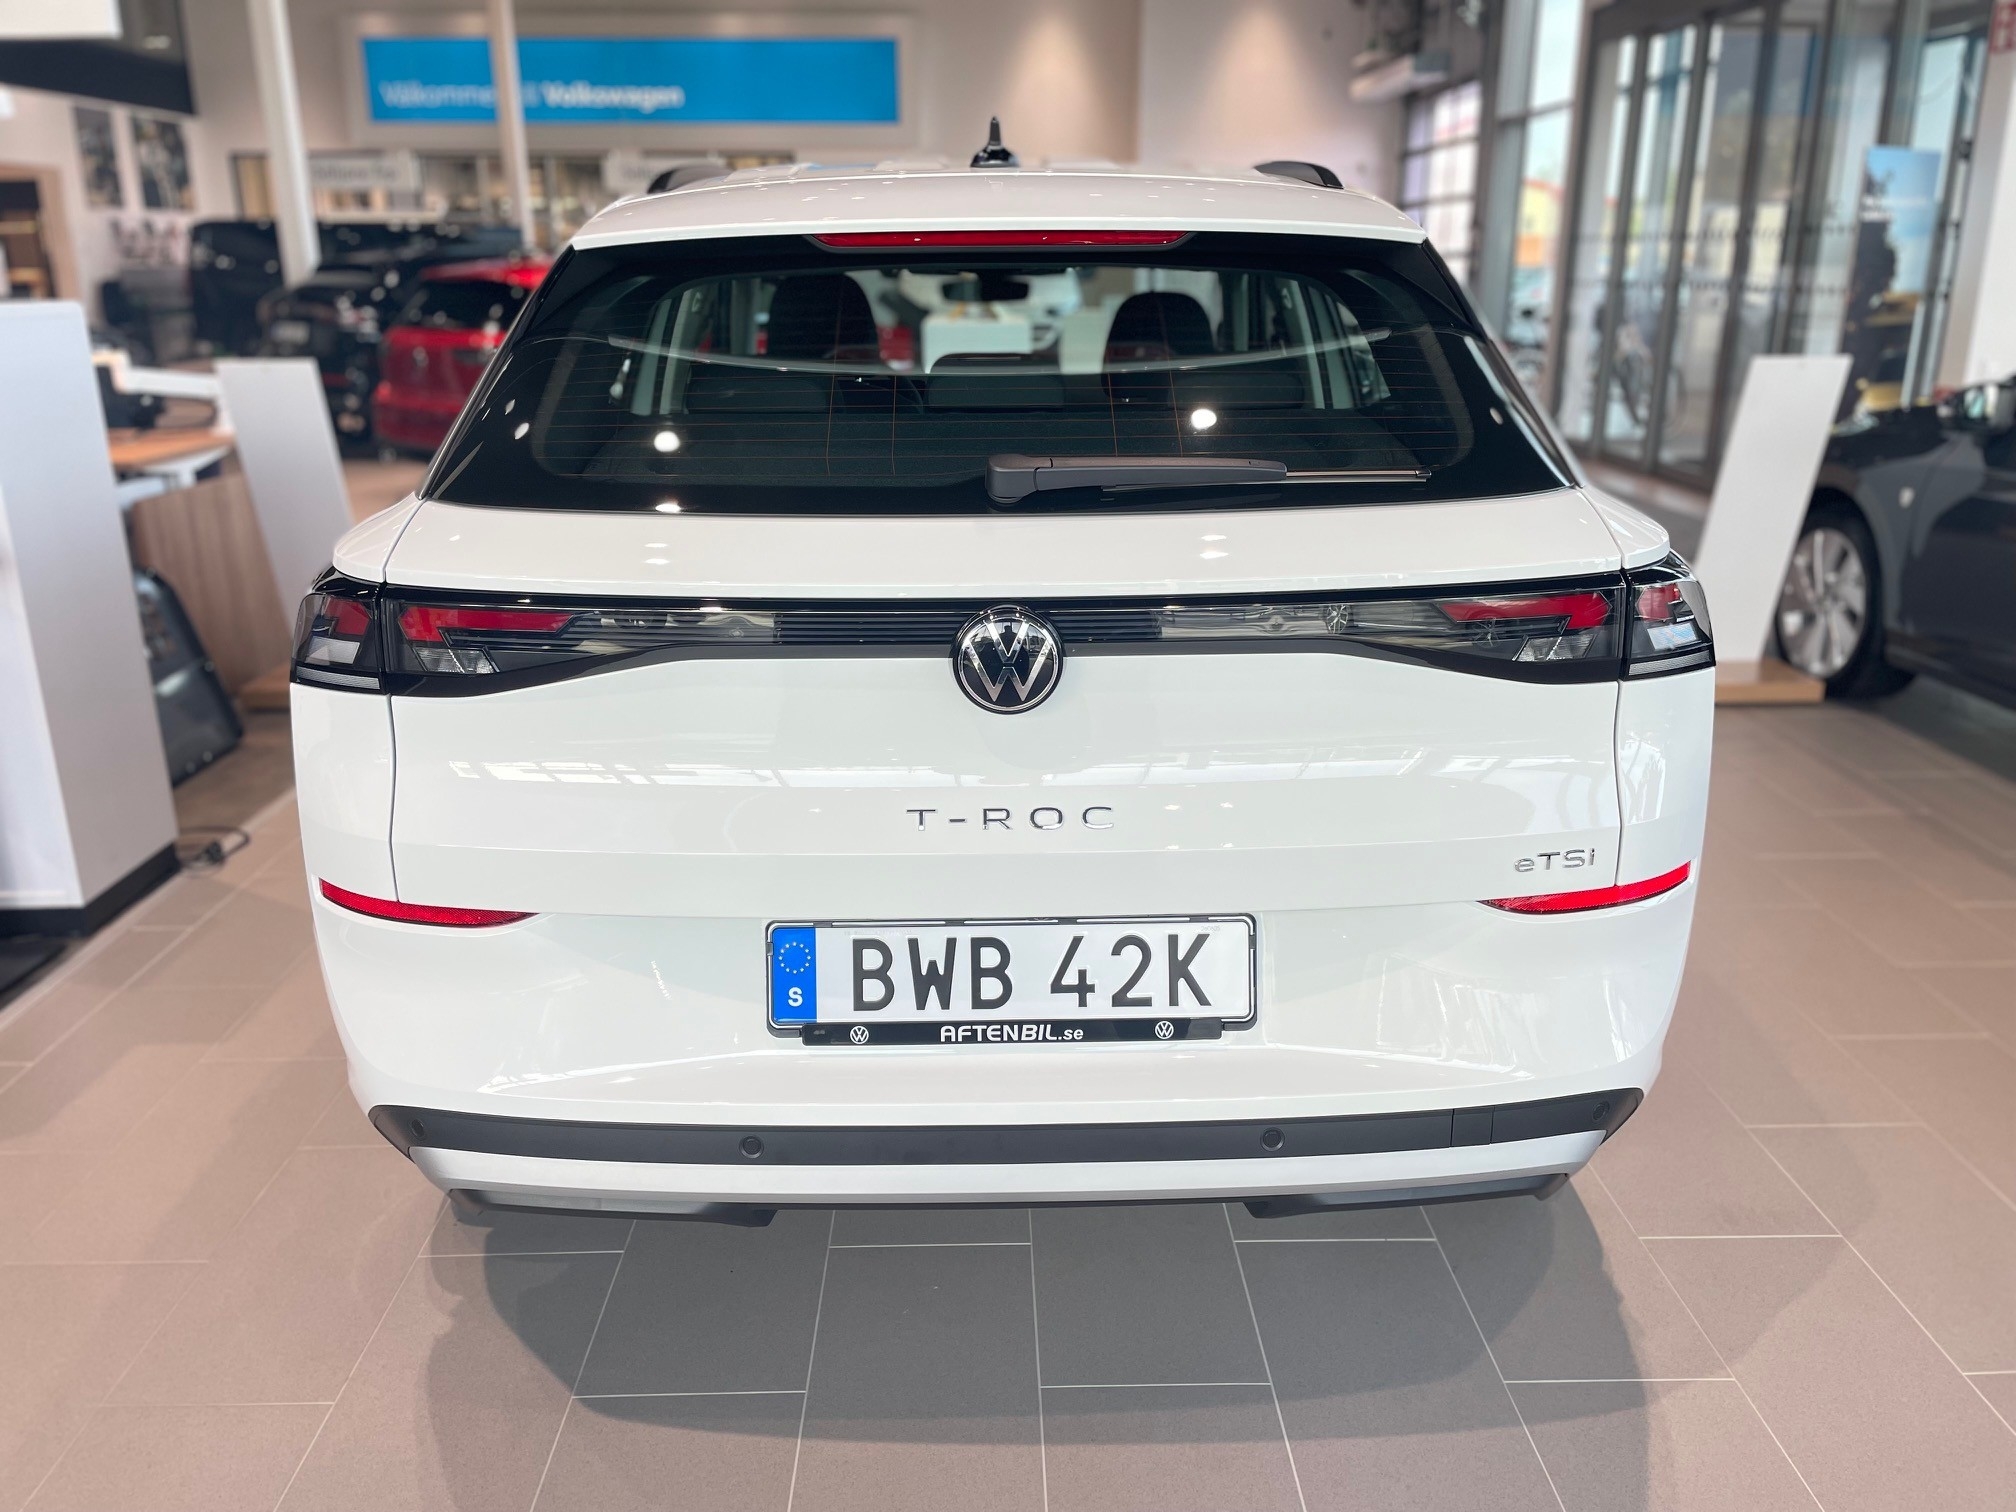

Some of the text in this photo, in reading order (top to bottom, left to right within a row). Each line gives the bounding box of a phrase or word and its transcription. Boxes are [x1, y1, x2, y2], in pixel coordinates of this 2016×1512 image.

[906, 806, 1114, 831] T-ROC
[1514, 848, 1595, 873] eTSi
[852, 933, 1213, 1012] BWB 42K
[787, 986, 803, 1007] S
[940, 1024, 1084, 1043] AFTENBIL.se
